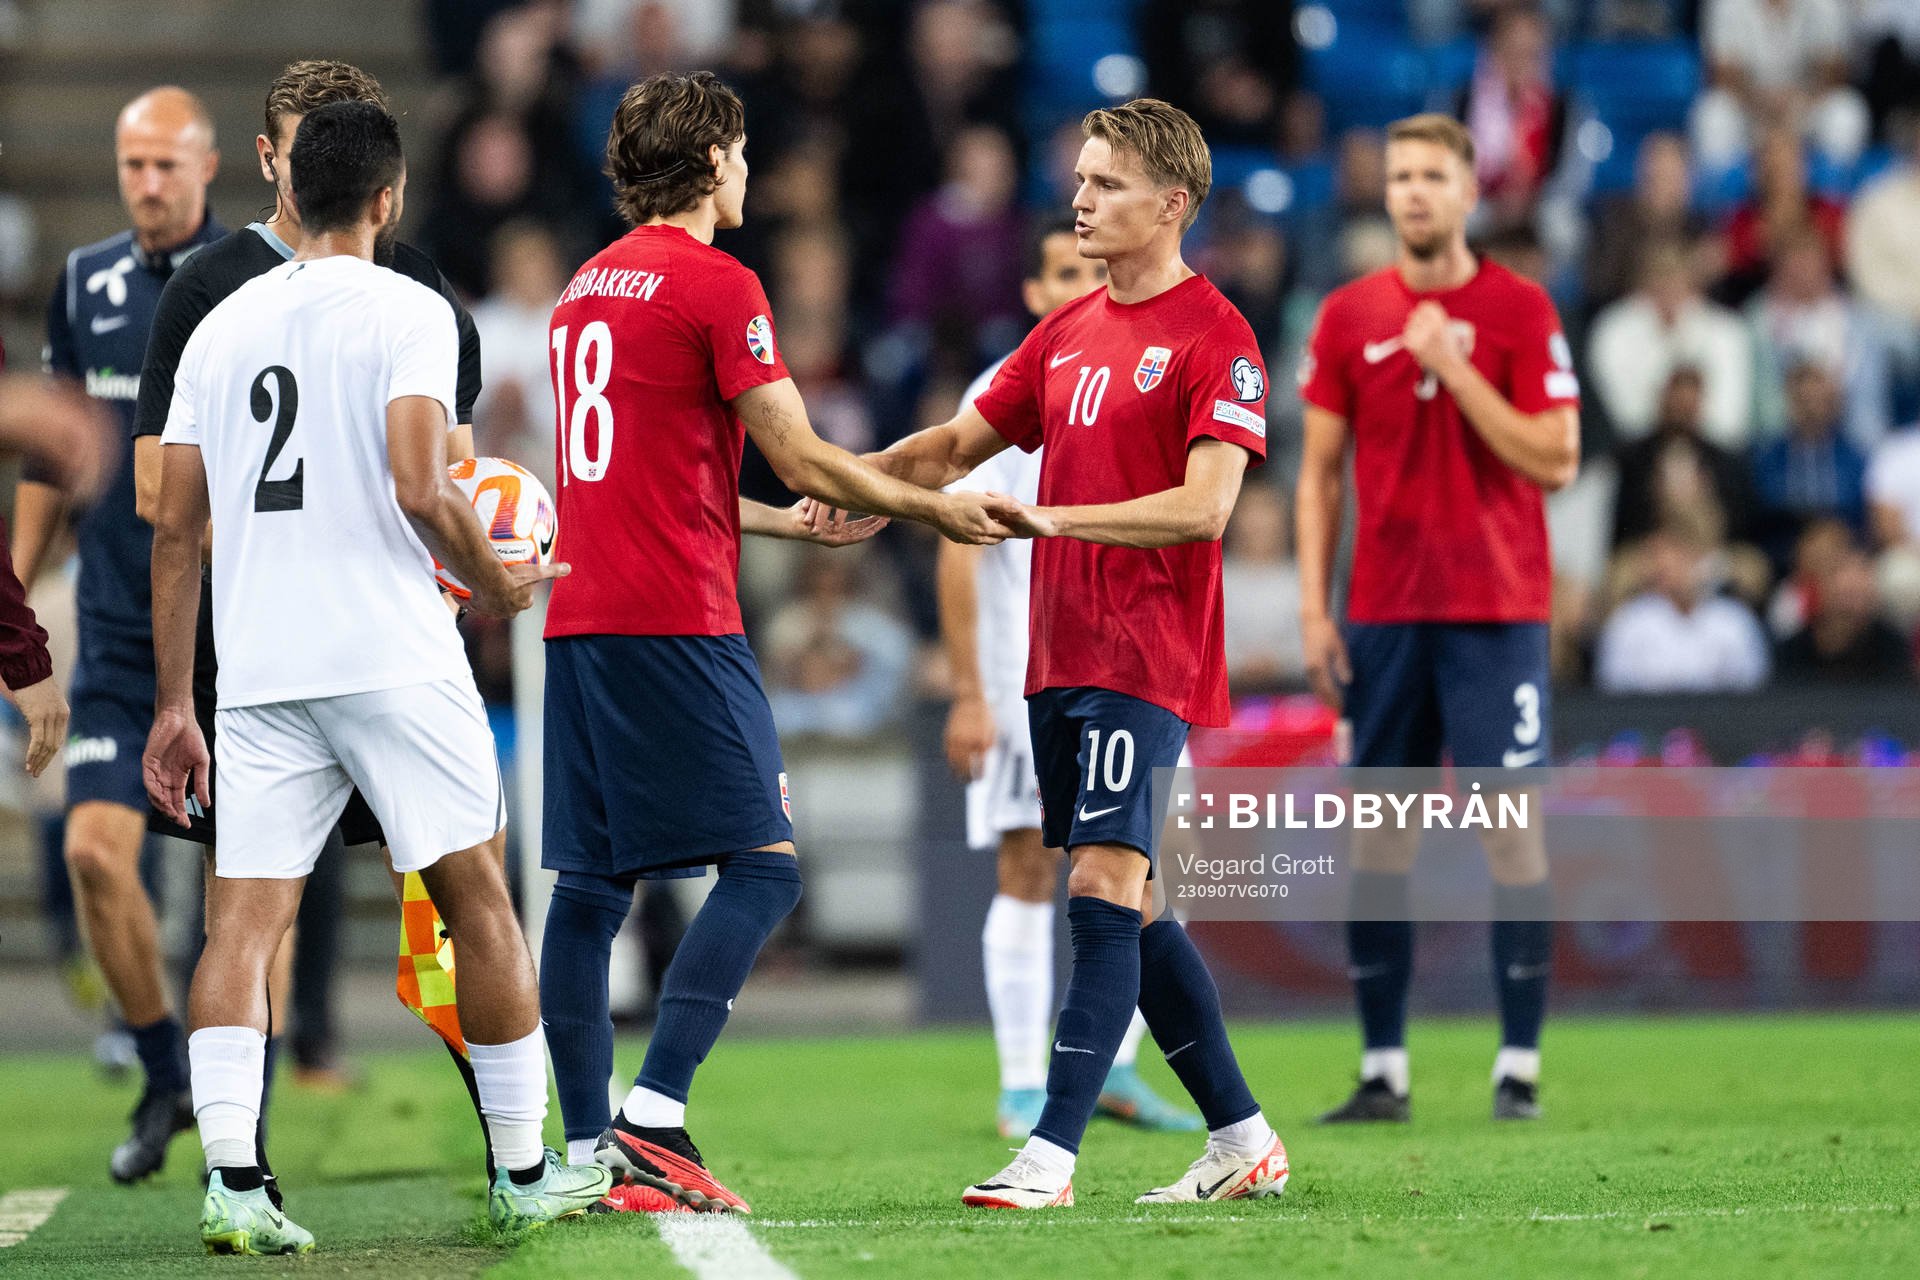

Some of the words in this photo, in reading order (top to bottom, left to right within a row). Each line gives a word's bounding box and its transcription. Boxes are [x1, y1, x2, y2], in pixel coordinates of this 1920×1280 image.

[552, 320, 614, 488] 18
[1068, 366, 1111, 427] 10
[250, 365, 303, 513] 2
[1514, 683, 1541, 745] 3
[1086, 729, 1135, 792] 10
